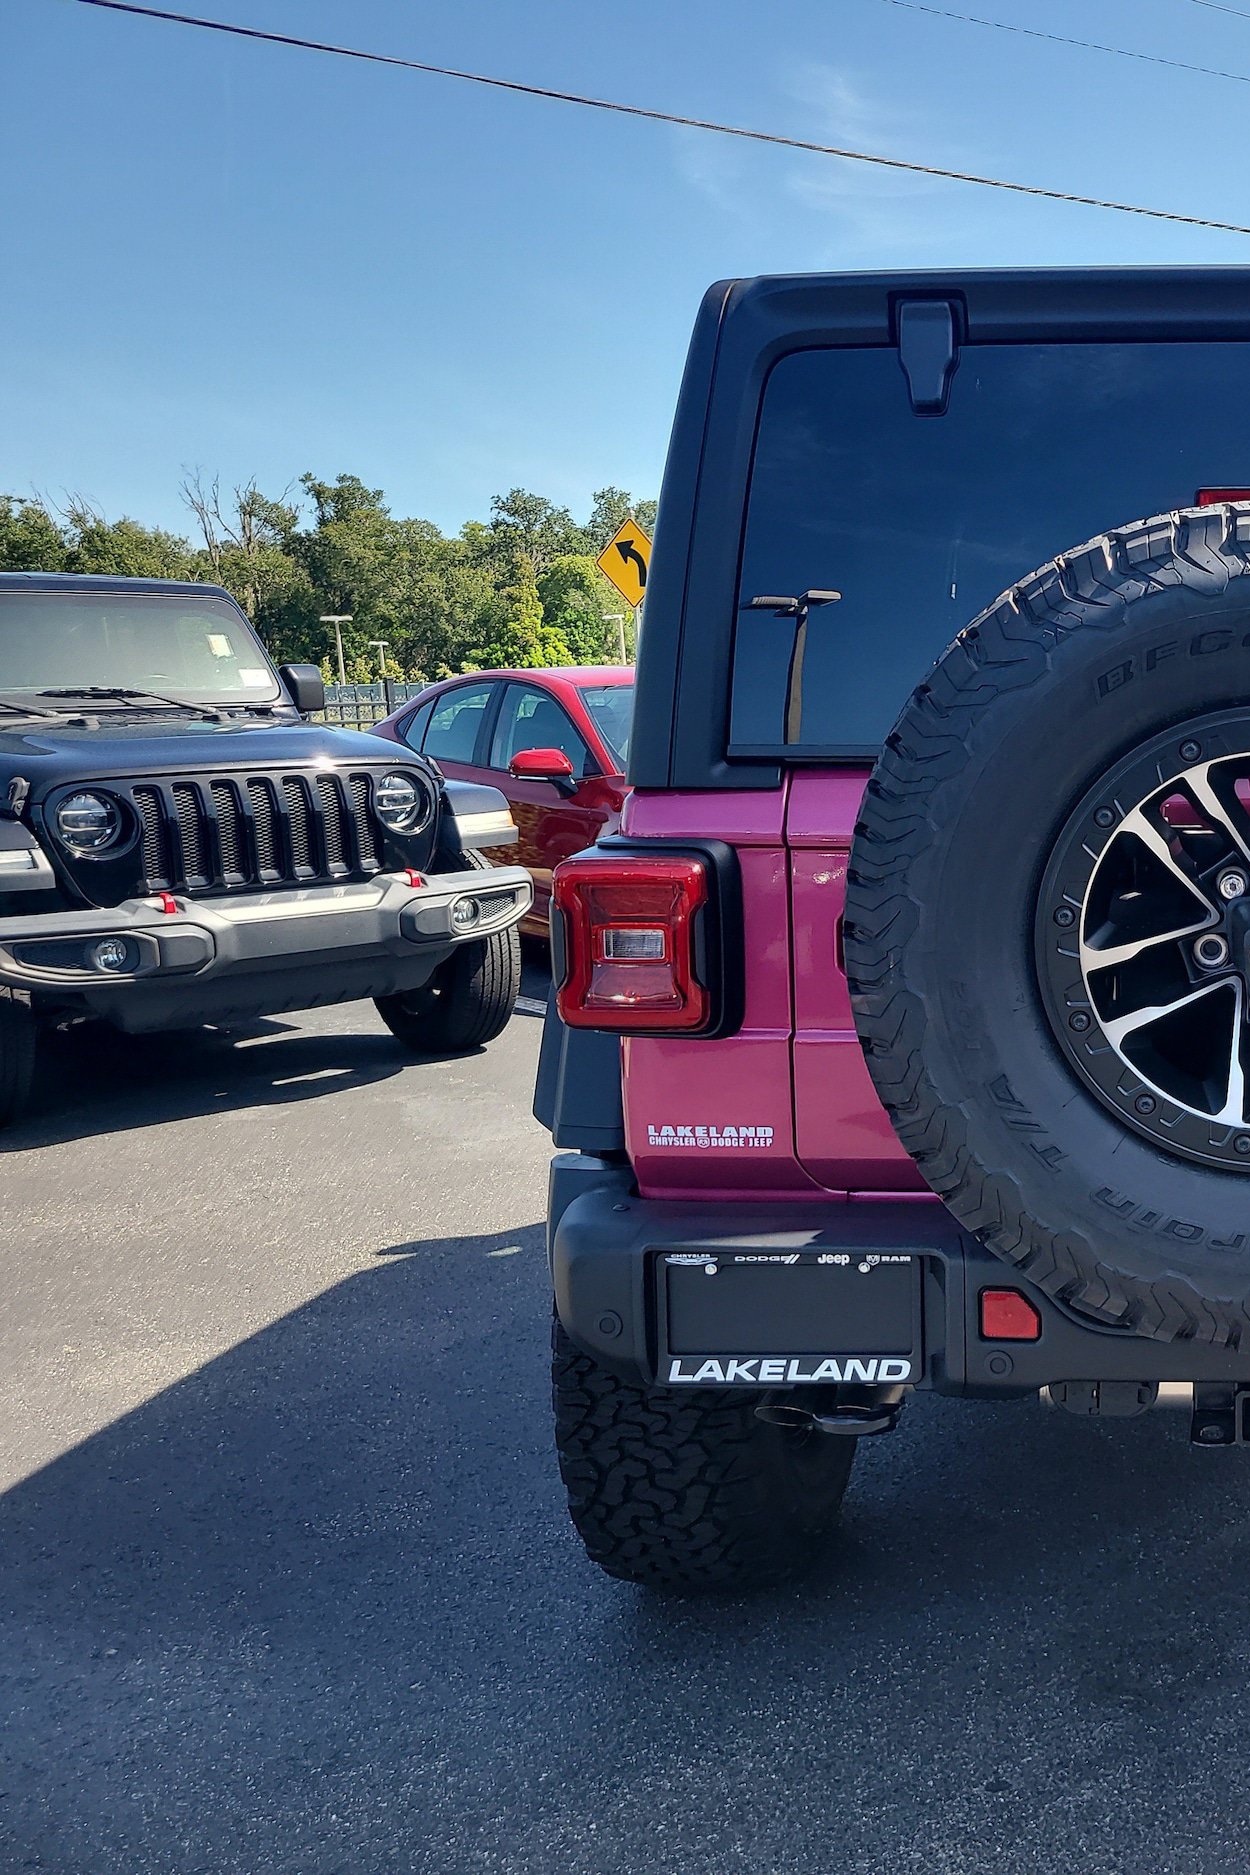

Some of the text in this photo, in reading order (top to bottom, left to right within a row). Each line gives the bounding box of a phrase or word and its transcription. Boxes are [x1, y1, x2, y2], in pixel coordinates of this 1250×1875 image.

[983, 1073, 1069, 1174] T/A
[647, 1125, 774, 1138] LAKELAND
[649, 1136, 773, 1147] CHRYSLER DODGE JEEP
[734, 1255, 791, 1263] DODGE
[817, 1254, 850, 1265] Jeep
[881, 1255, 911, 1263] RAM
[668, 1359, 912, 1382] LAKELAND
